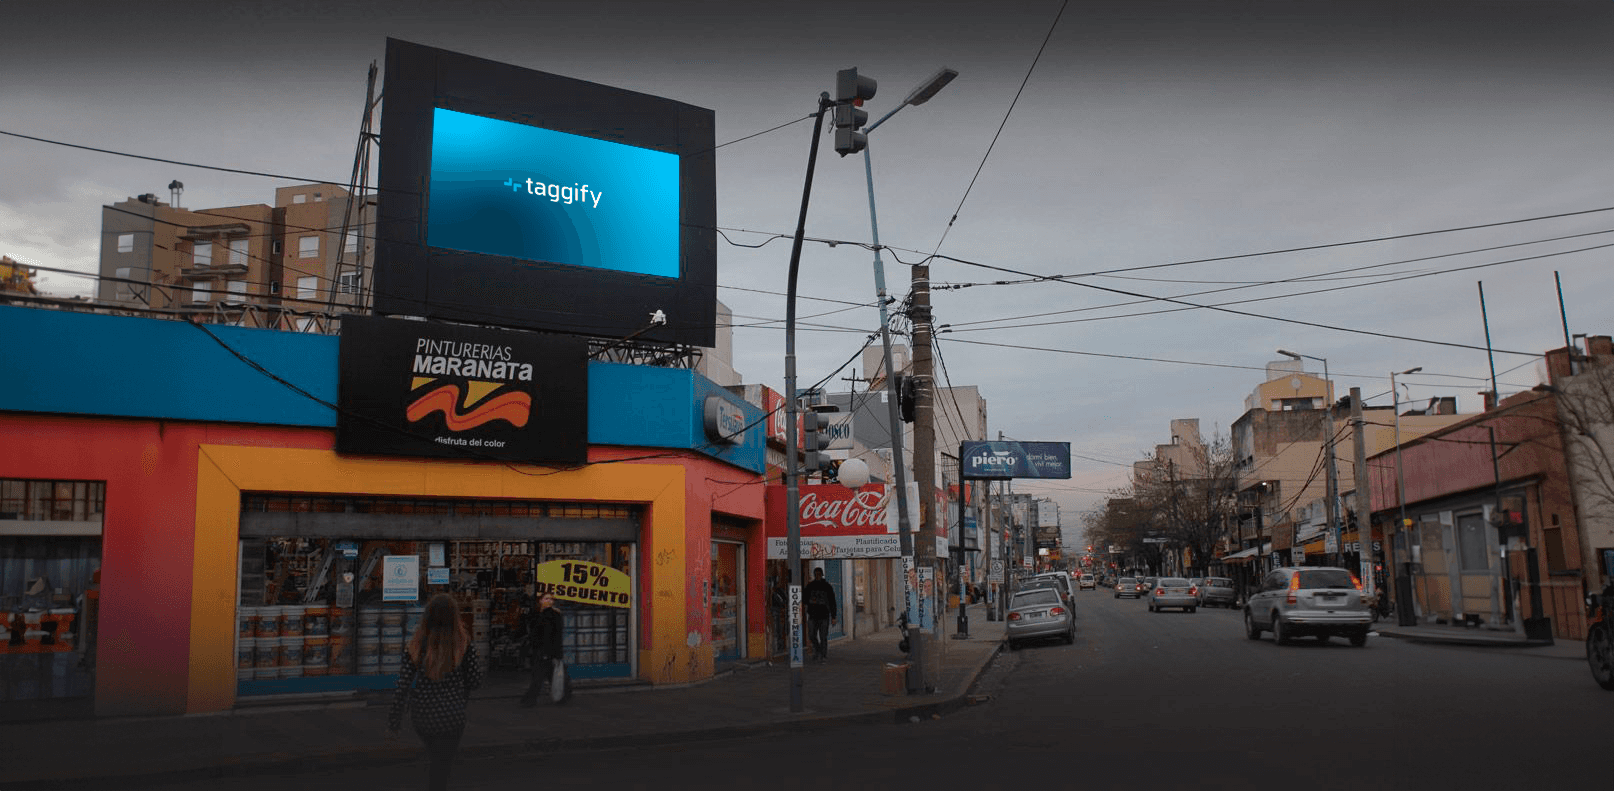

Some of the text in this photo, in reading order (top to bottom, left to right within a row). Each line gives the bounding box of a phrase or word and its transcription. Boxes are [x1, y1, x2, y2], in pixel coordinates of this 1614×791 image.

[525, 177, 603, 209] taggify
[416, 338, 512, 361] PINTURERIAS
[469, 438, 482, 447] del
[484, 440, 505, 448] color
[972, 451, 1016, 468] piero
[560, 562, 609, 587] 15%
[536, 582, 629, 604] DESCUENTO
